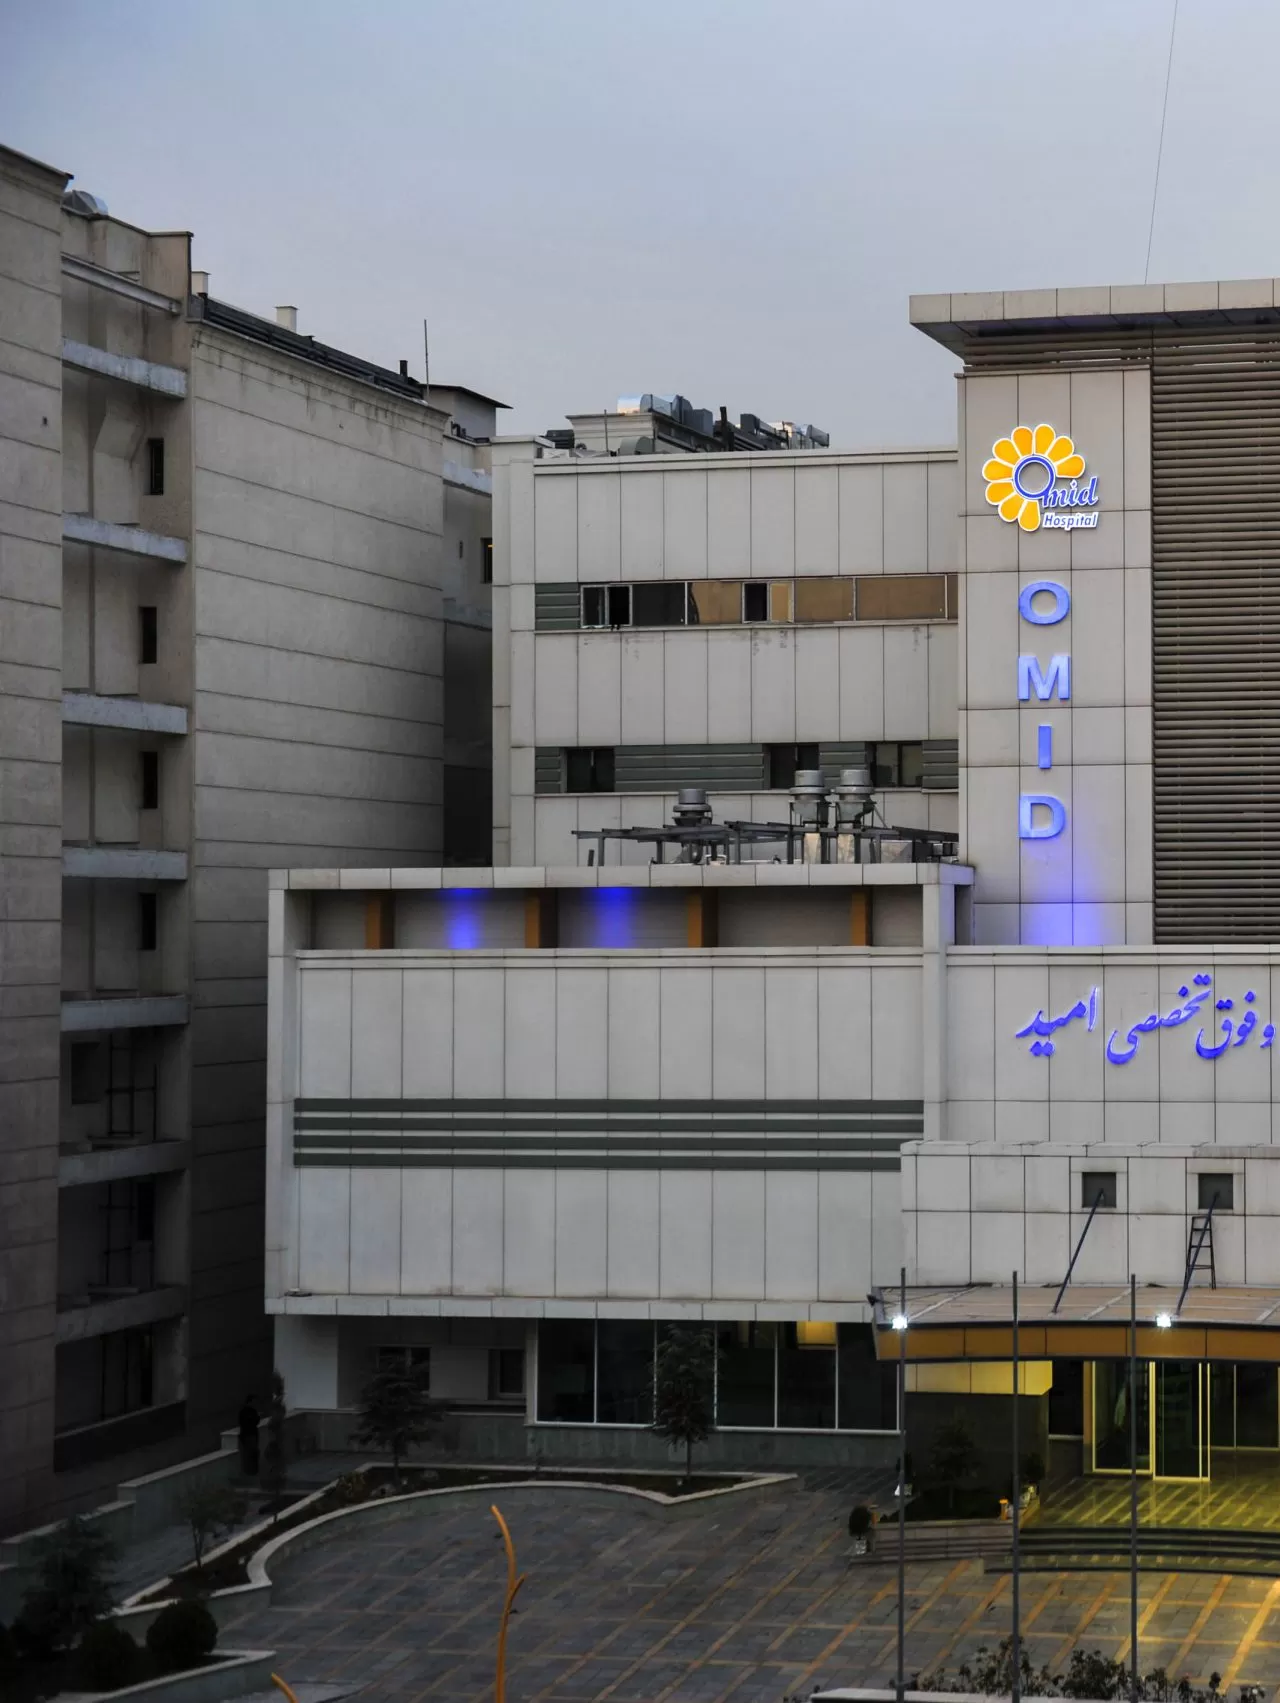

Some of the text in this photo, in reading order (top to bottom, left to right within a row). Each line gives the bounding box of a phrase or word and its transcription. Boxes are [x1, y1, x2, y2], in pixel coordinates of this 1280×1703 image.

[1043, 512, 1098, 530] Hospital
[1017, 581, 1071, 839] OMID
[1014, 986, 1099, 1058] امید
[1105, 972, 1212, 1066] تخصصی
